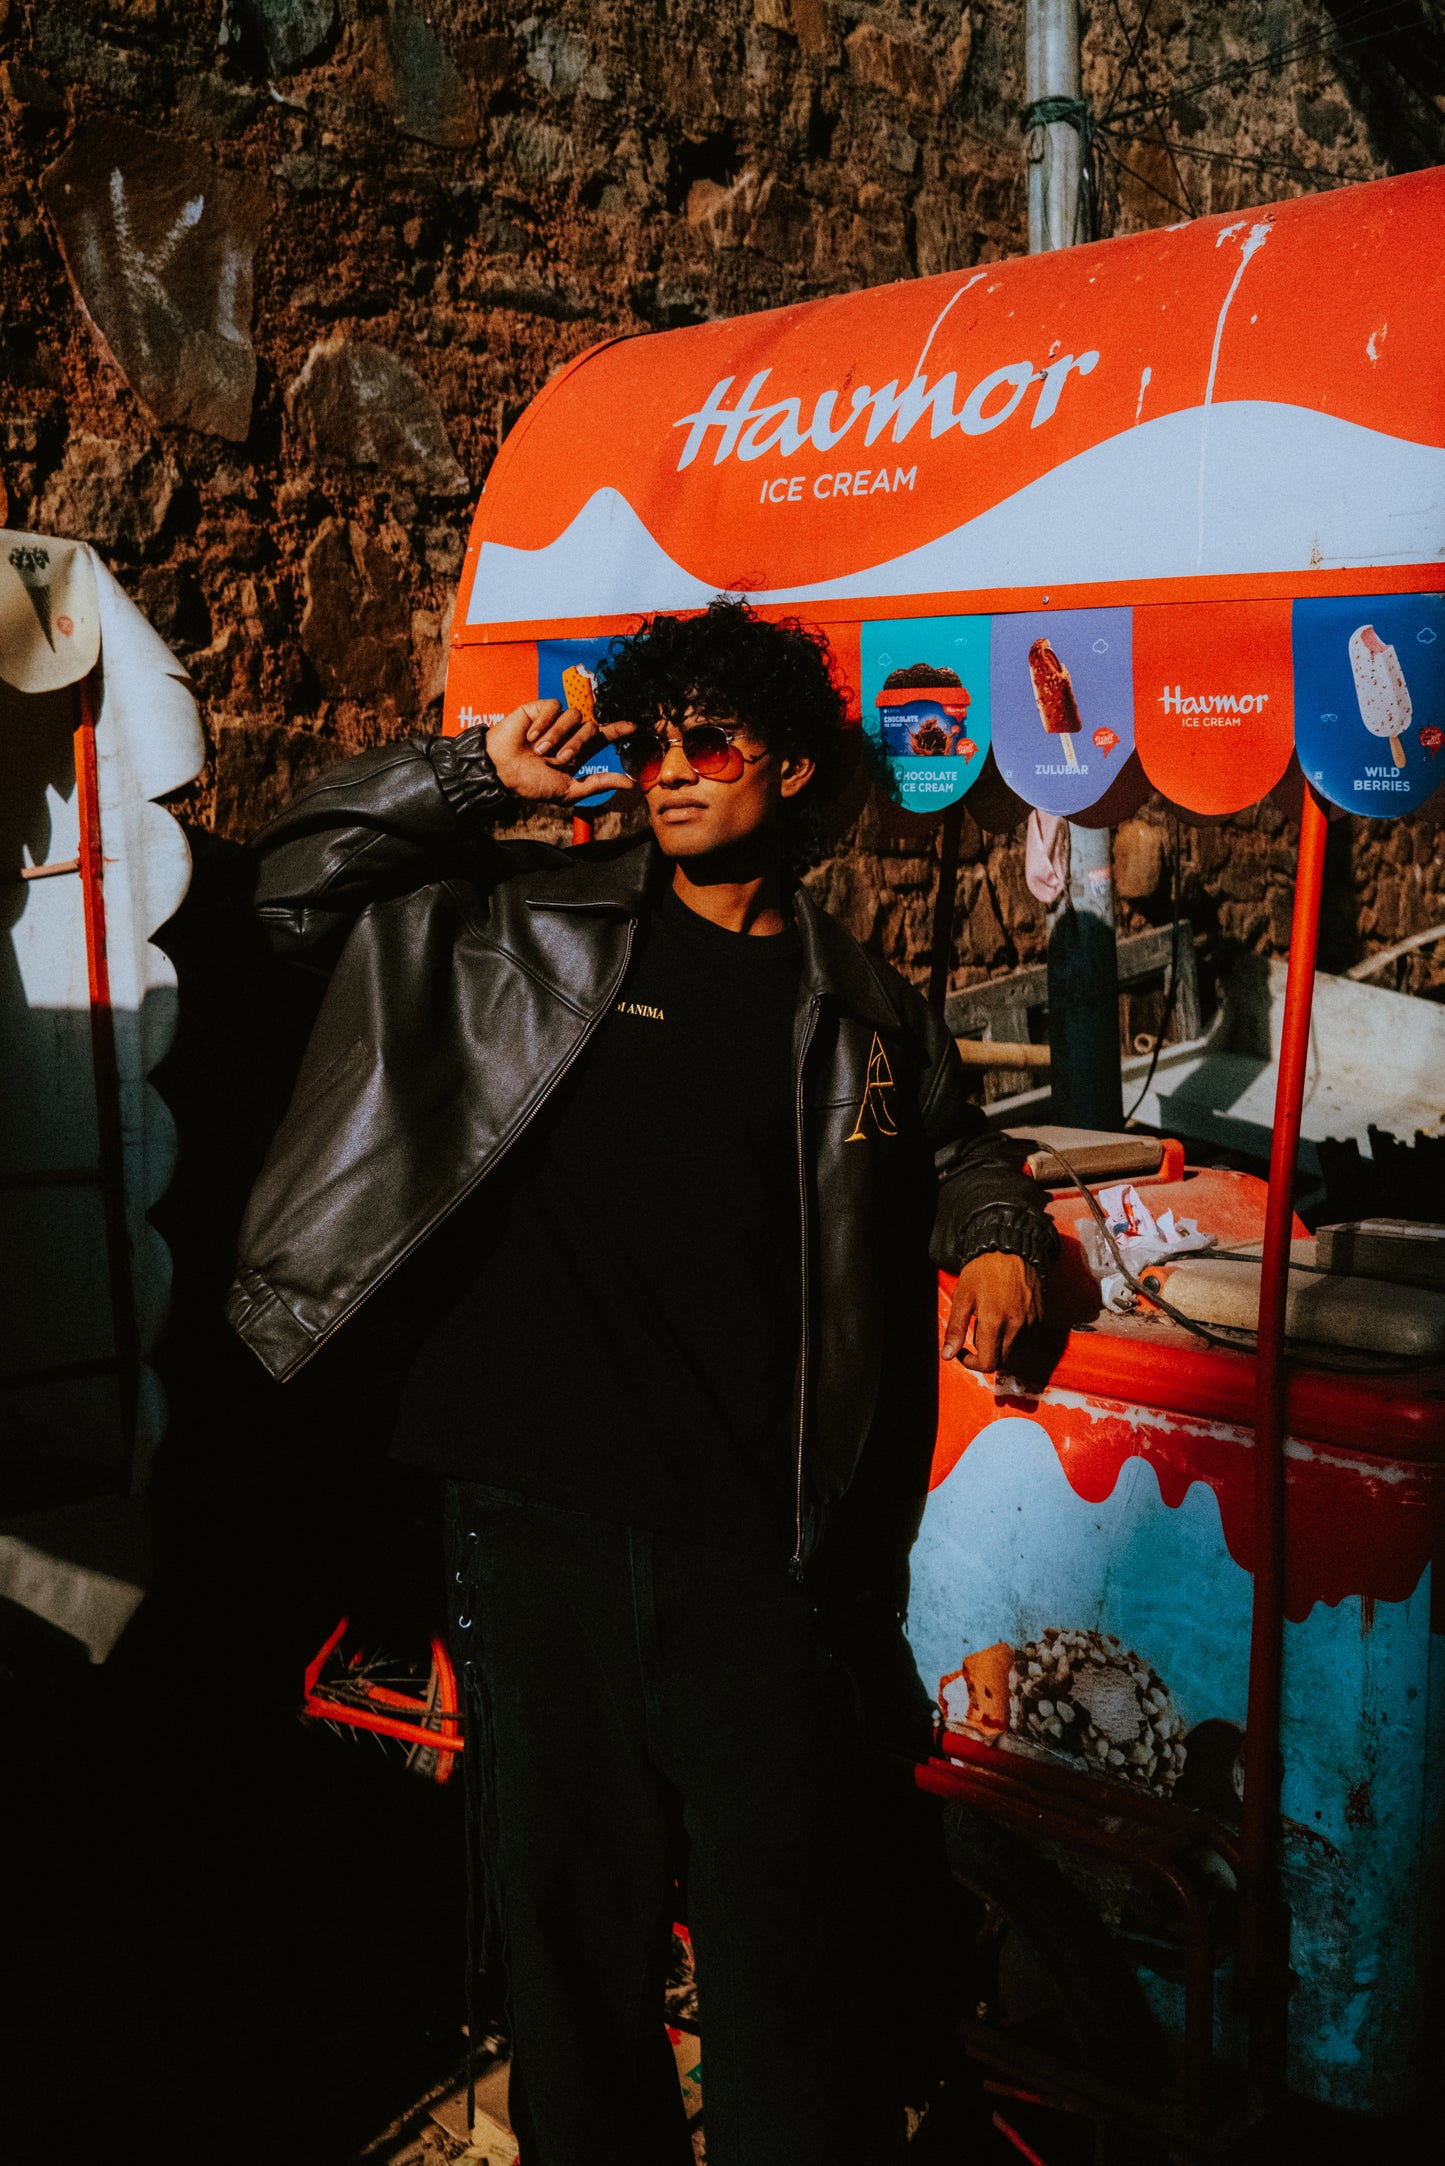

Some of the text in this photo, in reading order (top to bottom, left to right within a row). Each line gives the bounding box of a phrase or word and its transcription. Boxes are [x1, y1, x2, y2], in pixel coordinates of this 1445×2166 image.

[672, 350, 1100, 472] Havmor
[759, 466, 917, 503] ICE CREAM
[1157, 686, 1269, 715] Havmor
[1182, 717, 1241, 728] ICE CREAM
[1035, 764, 1089, 775] ZULUBAR
[1364, 766, 1400, 778] WILD
[895, 771, 958, 781] CHOCOLATE
[918, 782, 954, 793] CREAM
[1353, 779, 1411, 792] BERRIES
[626, 1003, 665, 1020] ANIMA
